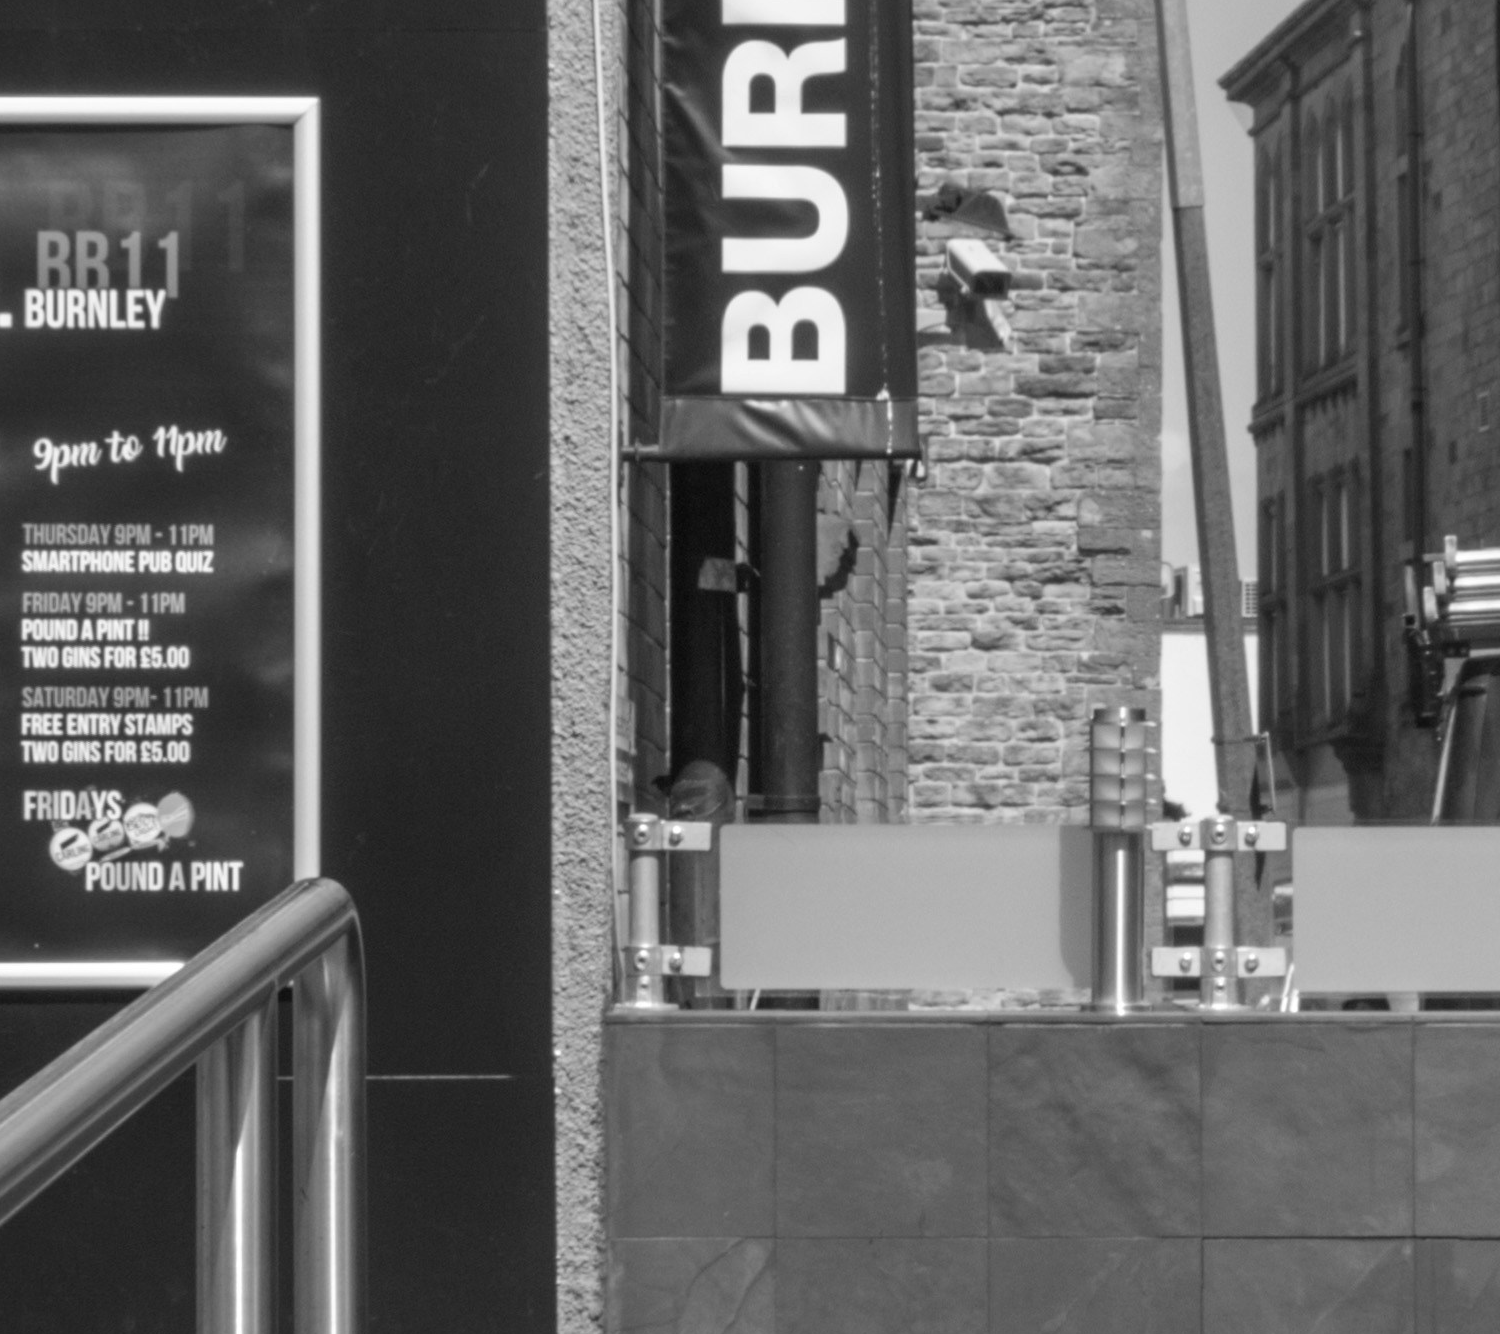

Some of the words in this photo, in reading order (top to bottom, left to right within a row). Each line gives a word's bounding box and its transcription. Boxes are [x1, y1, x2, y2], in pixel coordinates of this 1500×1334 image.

[37, 230, 179, 298] BB11
[24, 288, 167, 330] BURNLEY
[33, 436, 102, 484] 9pm
[105, 430, 143, 463] to
[153, 425, 227, 472] 11pm
[22, 524, 111, 546] THURSDAY
[114, 524, 151, 546] 9PM
[169, 524, 214, 546] 11PM
[21, 550, 135, 573] SMARTPHONE
[138, 550, 173, 573] PUB
[175, 550, 214, 573] QUIZ
[22, 592, 82, 614] FRIDAY
[85, 592, 122, 614] 9PM
[140, 592, 186, 614] 11PM
[21, 619, 78, 641] POUND
[80, 619, 94, 641] A
[97, 619, 135, 641] PINT
[21, 646, 59, 668] TWO
[62, 646, 101, 668] GINS
[104, 646, 137, 668] FOR
[140, 646, 191, 668] £5.00
[22, 686, 110, 708] SATURDAY
[163, 686, 209, 708] 11PM
[21, 713, 64, 736] FREE
[67, 713, 122, 736] ENTRY
[124, 713, 194, 736] STAMPS
[21, 740, 59, 763] TWO
[62, 740, 101, 763] GINS
[104, 740, 137, 763] FOR
[140, 740, 191, 763] £5.00
[23, 790, 123, 821] FRIDAYS
[85, 860, 164, 891] POUND
[168, 860, 186, 891] A
[190, 860, 244, 891] PINT
